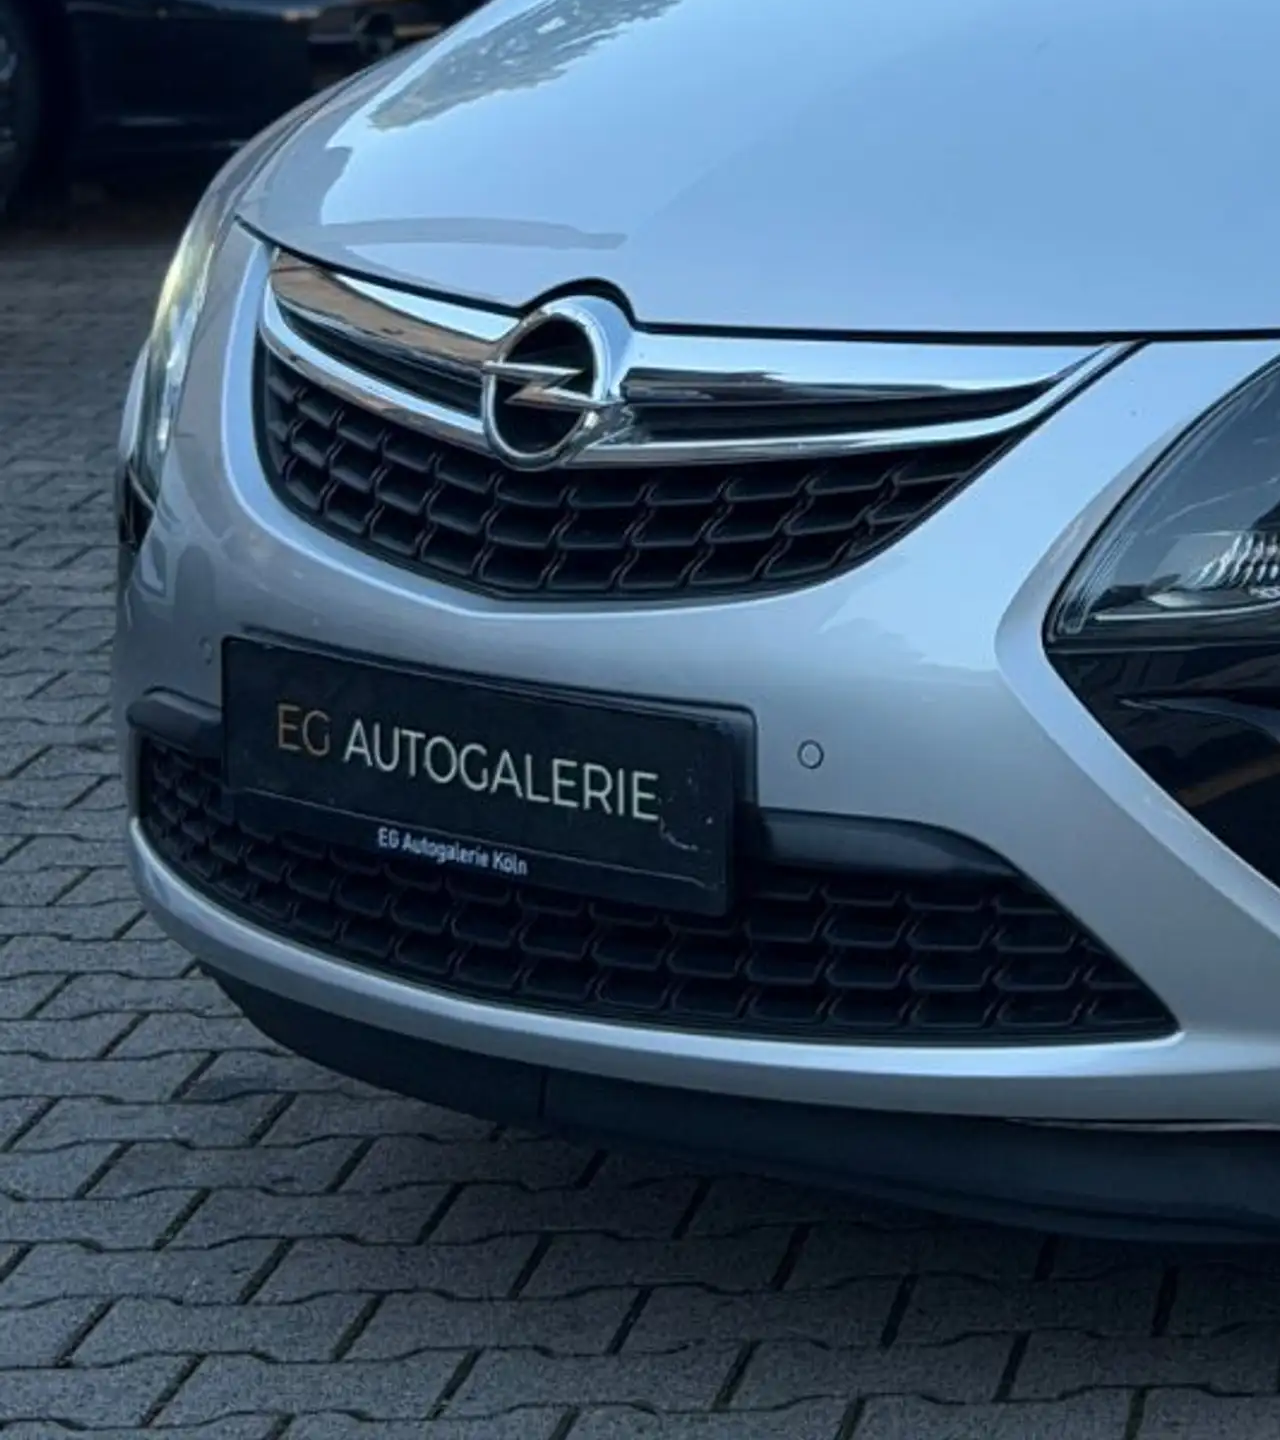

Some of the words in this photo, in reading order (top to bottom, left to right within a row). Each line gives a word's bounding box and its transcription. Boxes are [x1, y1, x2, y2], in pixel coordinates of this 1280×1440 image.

[277, 704, 330, 756] EG
[343, 719, 660, 822] AUTOGALERIE
[377, 827, 400, 849] EG
[402, 832, 490, 865] Autogalerie
[492, 850, 528, 875] Köln
